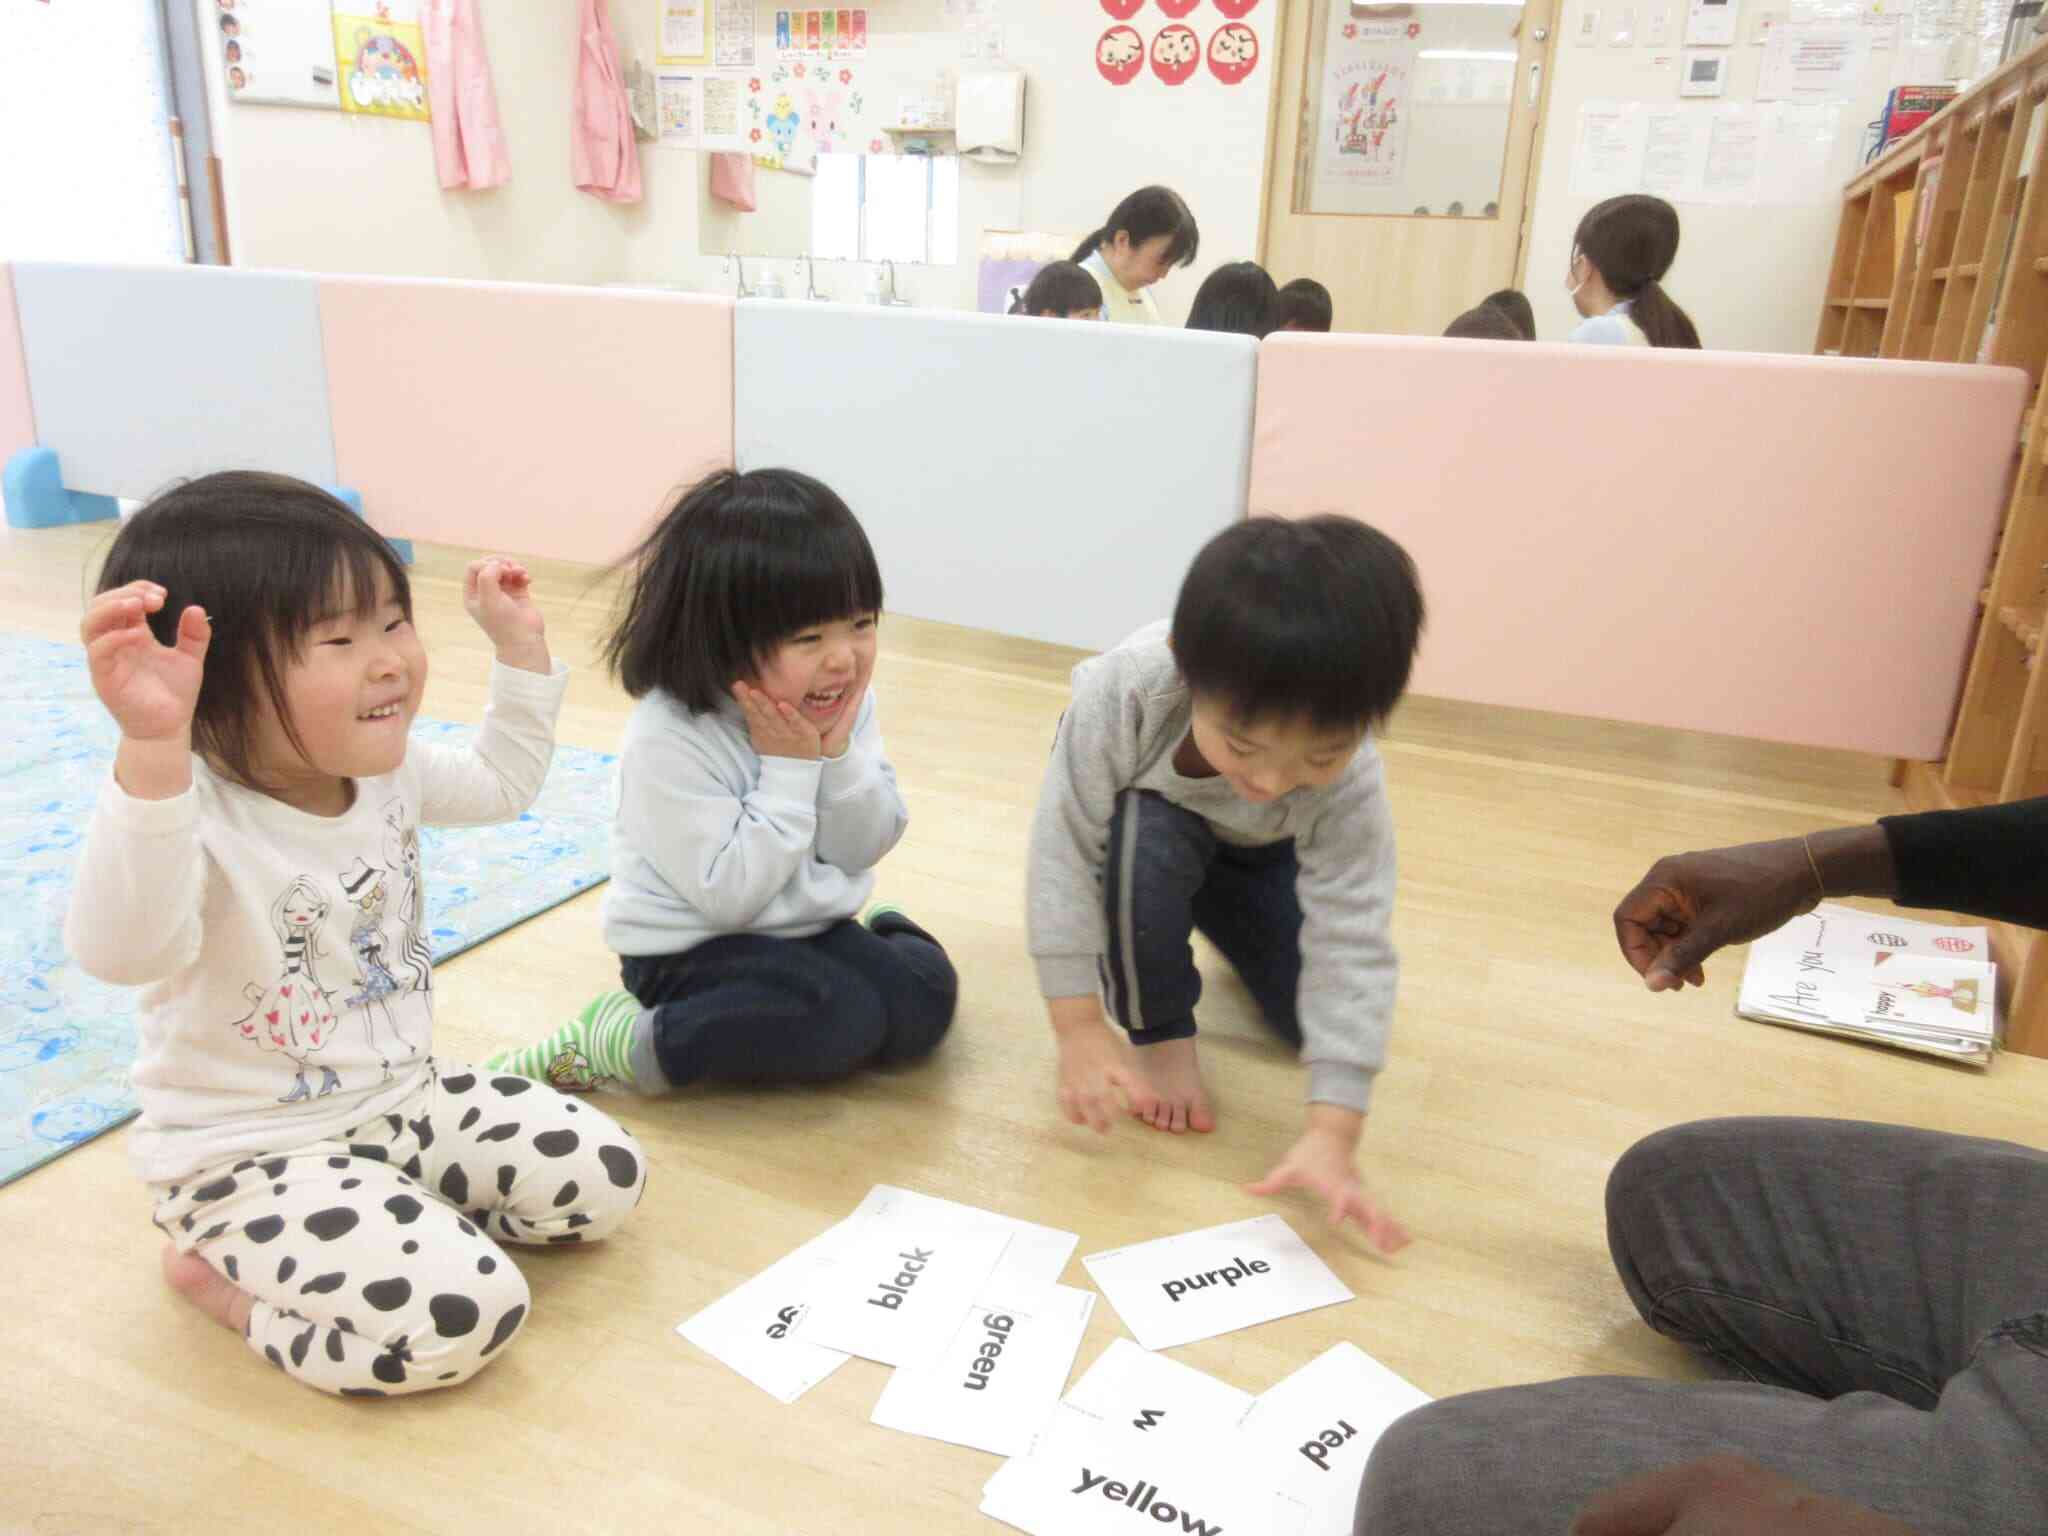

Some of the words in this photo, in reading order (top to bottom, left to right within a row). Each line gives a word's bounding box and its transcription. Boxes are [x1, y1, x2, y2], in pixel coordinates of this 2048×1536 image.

[1768, 981, 1820, 1010] Are
[1795, 951, 1836, 974] you
[1867, 991, 1896, 1016] happy
[867, 1247, 933, 1311] black
[1161, 1256, 1271, 1302] purple
[963, 1313, 1014, 1391] green
[1299, 1420, 1358, 1471] red
[1071, 1468, 1223, 1536] yellow
